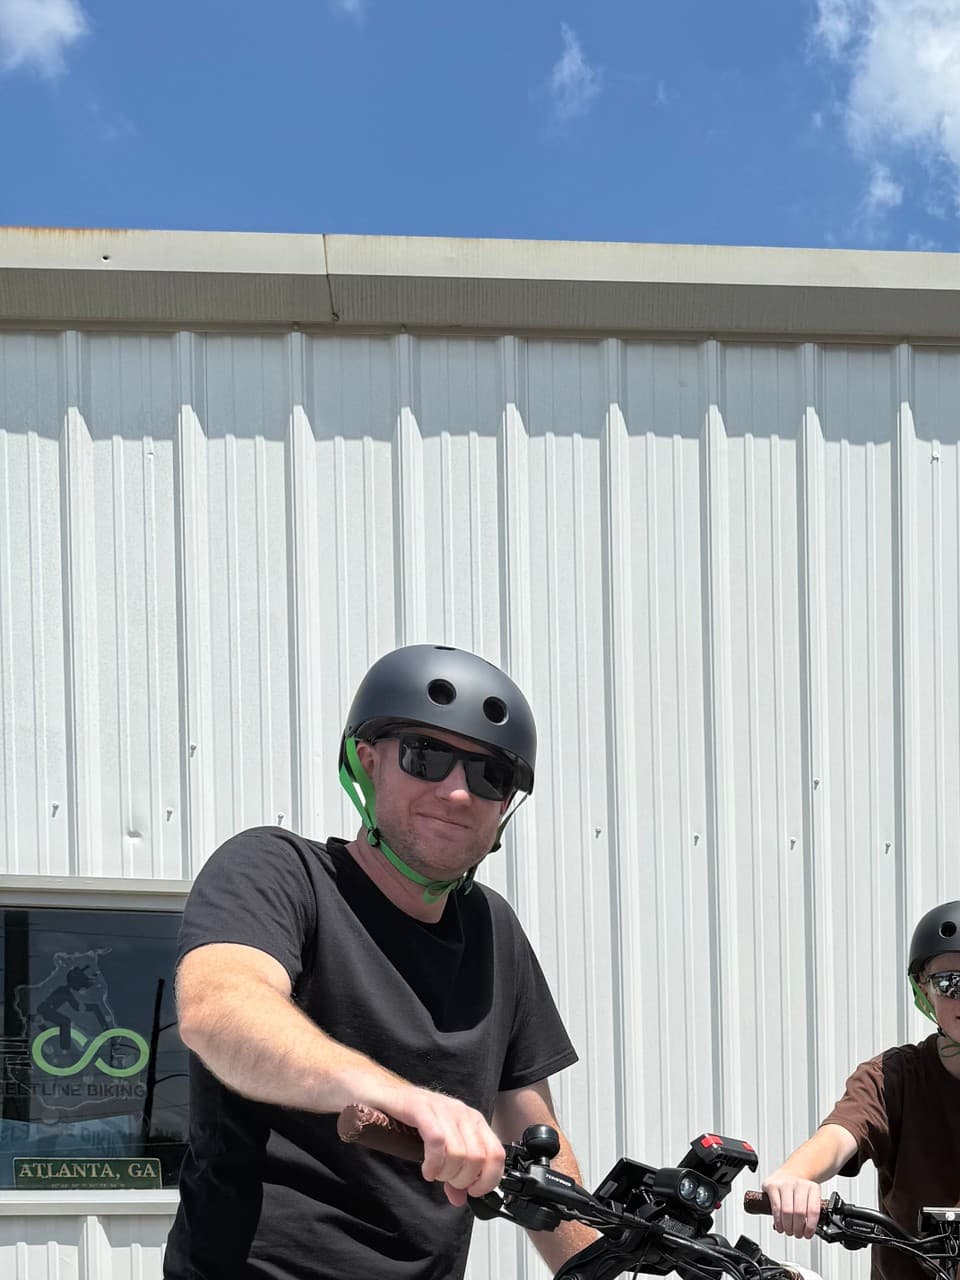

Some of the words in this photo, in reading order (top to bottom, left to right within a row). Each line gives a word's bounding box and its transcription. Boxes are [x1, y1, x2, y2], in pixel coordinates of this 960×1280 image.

[2, 1082, 81, 1097] ELTLINE
[87, 1083, 146, 1098] BIKING
[19, 1162, 121, 1180] ATLANTA,
[127, 1162, 158, 1178] GA
